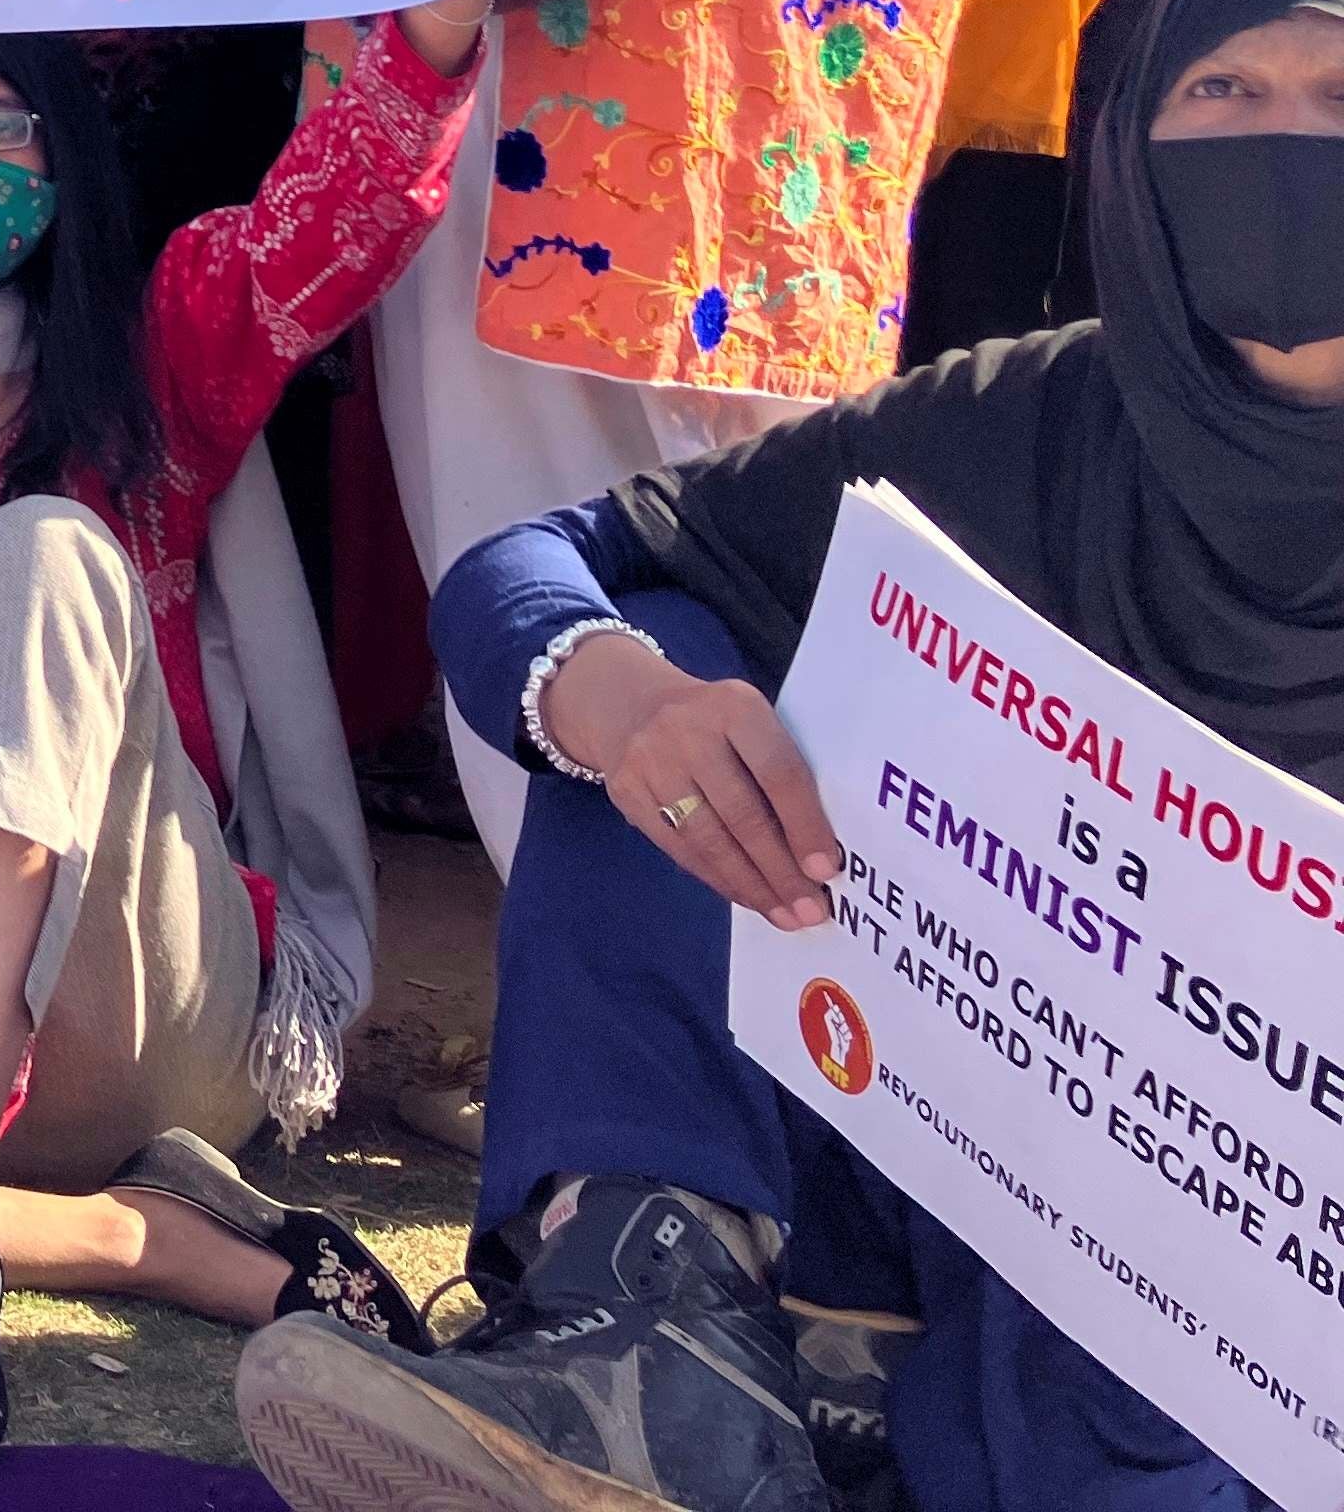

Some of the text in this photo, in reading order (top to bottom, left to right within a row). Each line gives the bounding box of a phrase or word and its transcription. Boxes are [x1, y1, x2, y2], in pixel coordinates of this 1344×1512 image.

[869, 570, 1344, 934] UNIVERSAL HOUS
[1056, 793, 1149, 902] is a
[877, 759, 1344, 1127] FEMINIST ISSUE
[893, 944, 1033, 1071] AFFORD
[1044, 1053, 1094, 1118] TO
[1108, 1104, 1267, 1247] ESCAPE
[914, 899, 1000, 989] WHO
[1011, 976, 1125, 1080] CAN'T
[1132, 1068, 1306, 1210] AFFORD
[878, 1062, 1064, 1231] REVOLUTIONARY
[1215, 1334, 1307, 1419] FRONT
